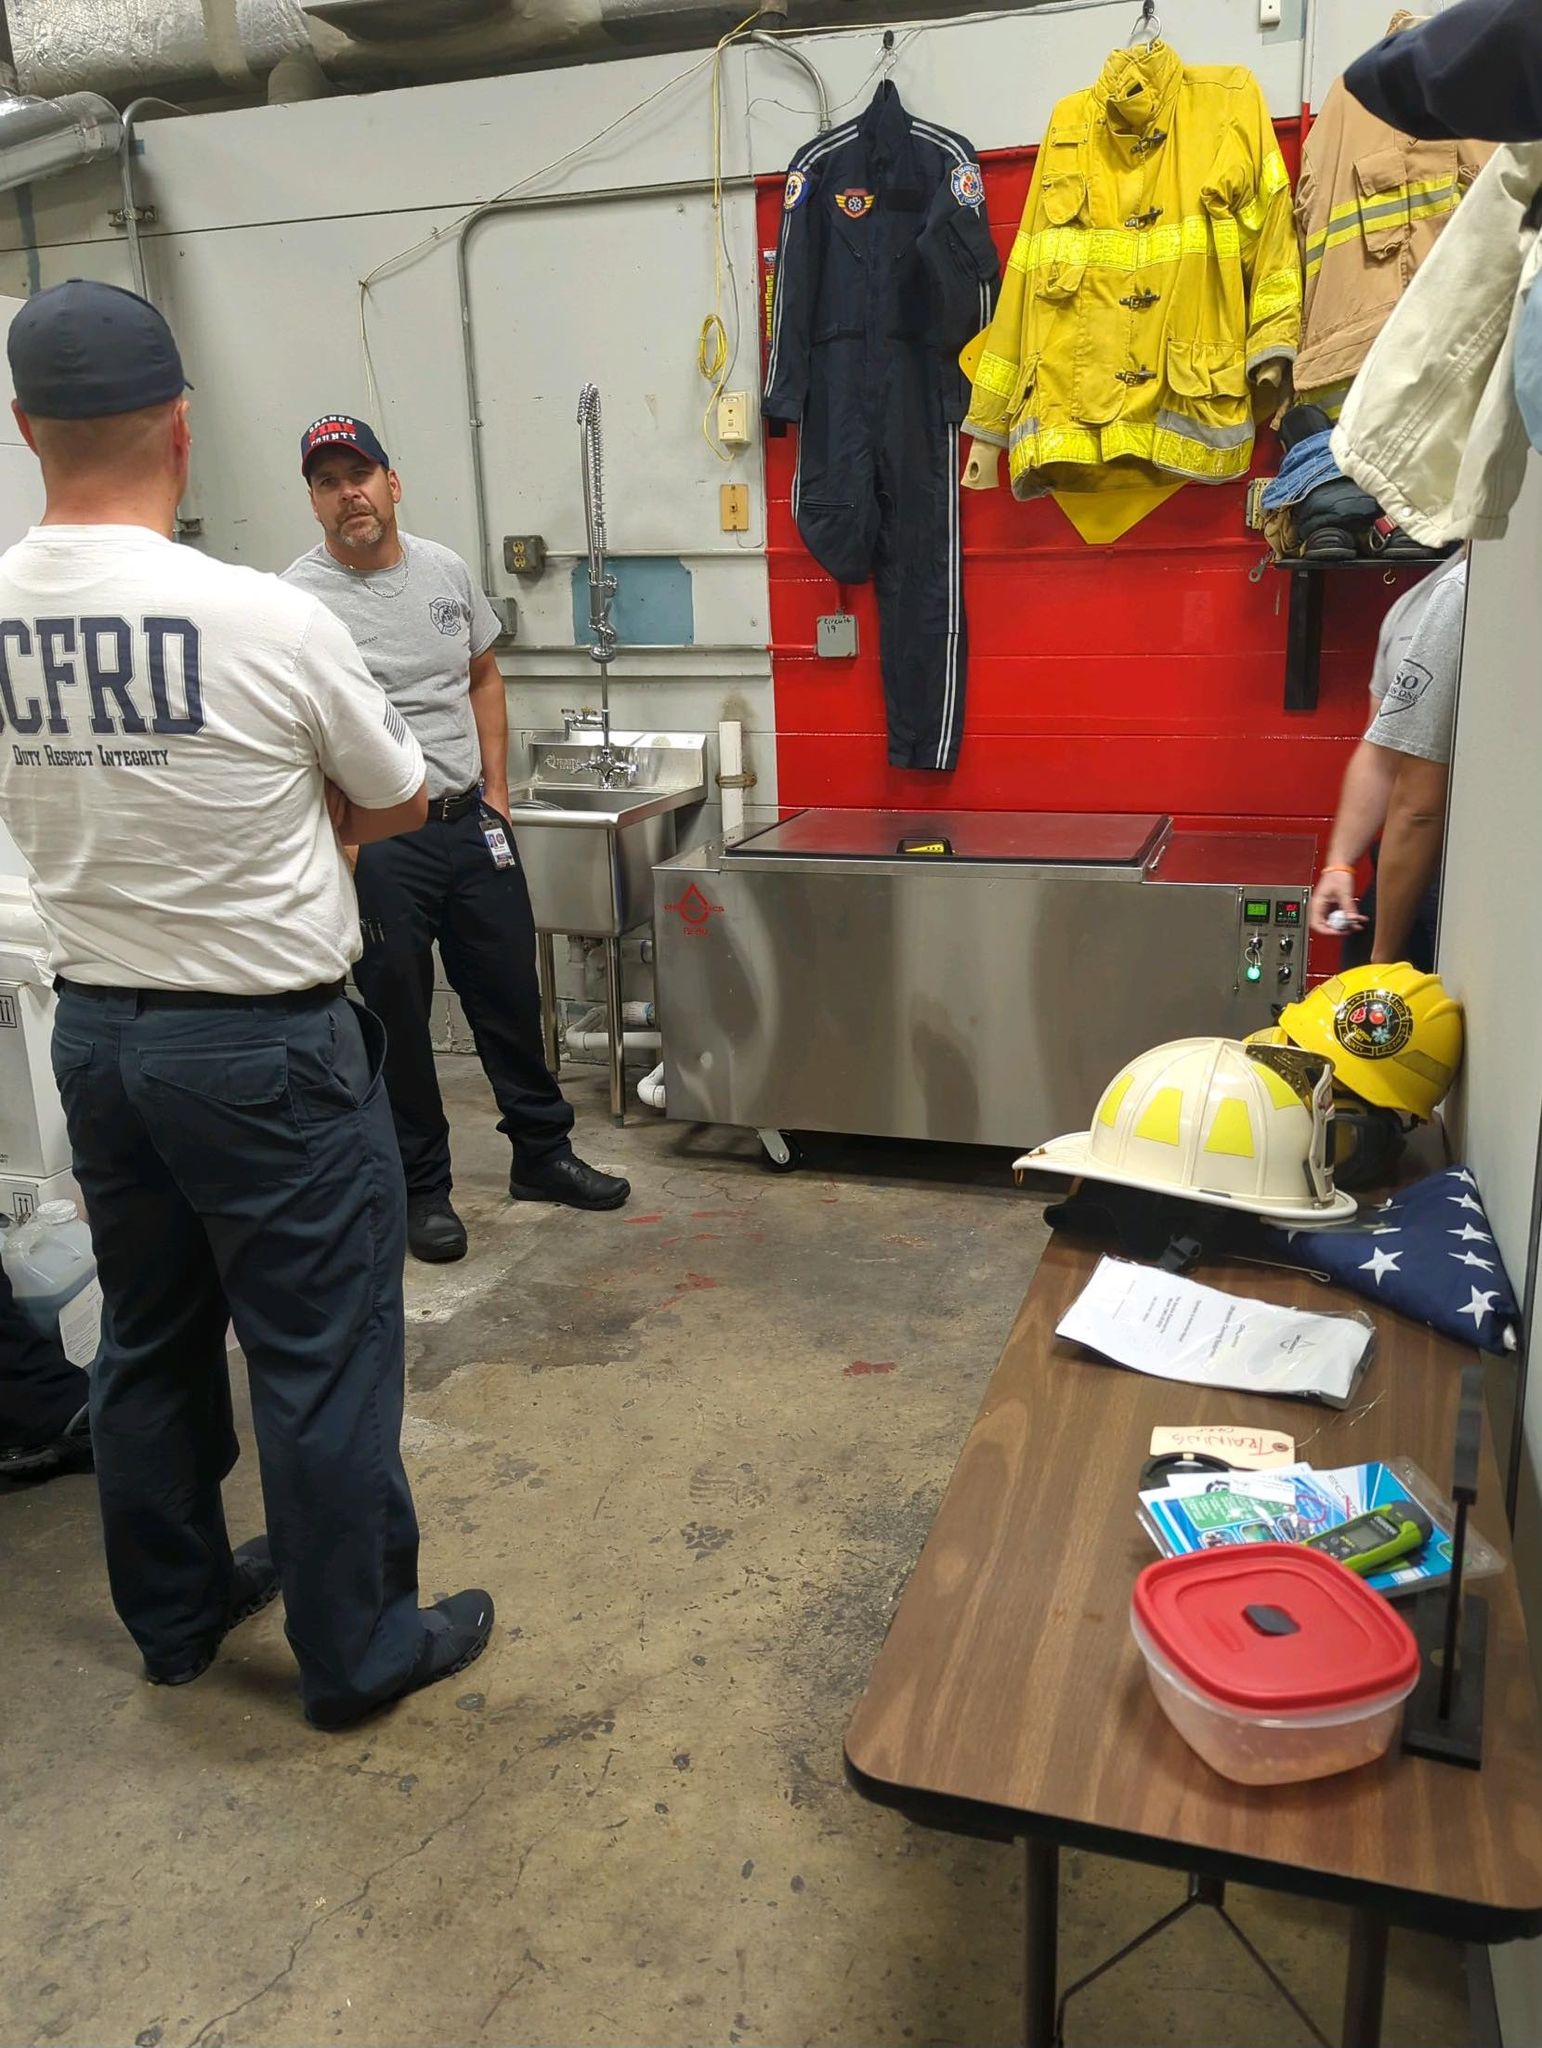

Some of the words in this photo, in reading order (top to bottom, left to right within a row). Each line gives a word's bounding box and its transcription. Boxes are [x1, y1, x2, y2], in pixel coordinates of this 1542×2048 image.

[308, 422, 356, 442] FIRE
[309, 416, 354, 433] ORANGE
[310, 432, 358, 447] COUNTY
[827, 625, 836, 633] 19
[0, 615, 207, 736] CFRD
[12, 744, 42, 767] DUTY
[43, 744, 94, 767] RESPECT
[97, 744, 170, 767] INTEGRITY
[1172, 1434, 1274, 1457] TRAINING
